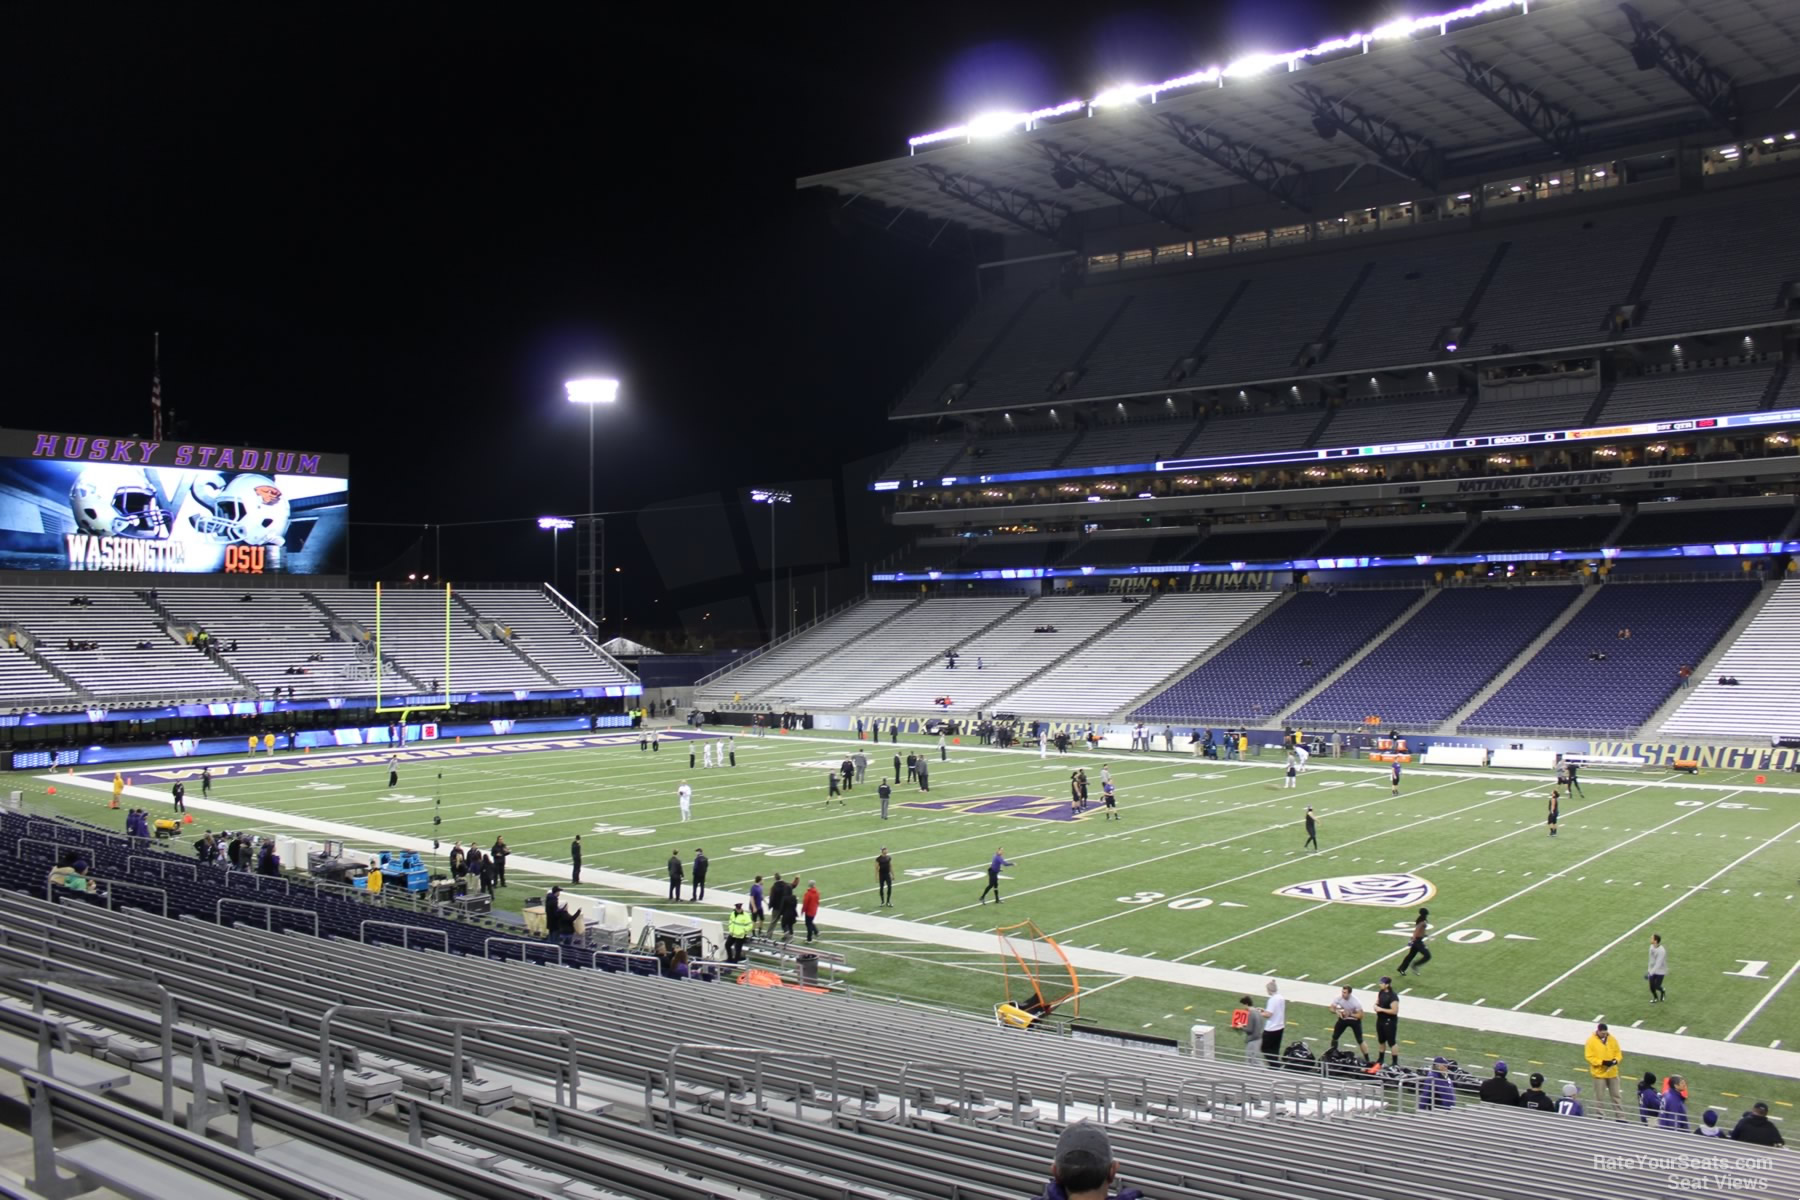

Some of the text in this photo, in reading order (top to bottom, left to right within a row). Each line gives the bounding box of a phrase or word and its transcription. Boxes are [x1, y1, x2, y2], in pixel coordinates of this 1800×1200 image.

[33, 434, 320, 474] HUSKY STADIUM
[1456, 471, 1614, 493] NATIONAL CHAMPIONS
[68, 534, 185, 563] WASHINGTON
[225, 544, 264, 570] OSU
[1234, 1011, 1247, 1025] 20
[1558, 1101, 1573, 1116] 17
